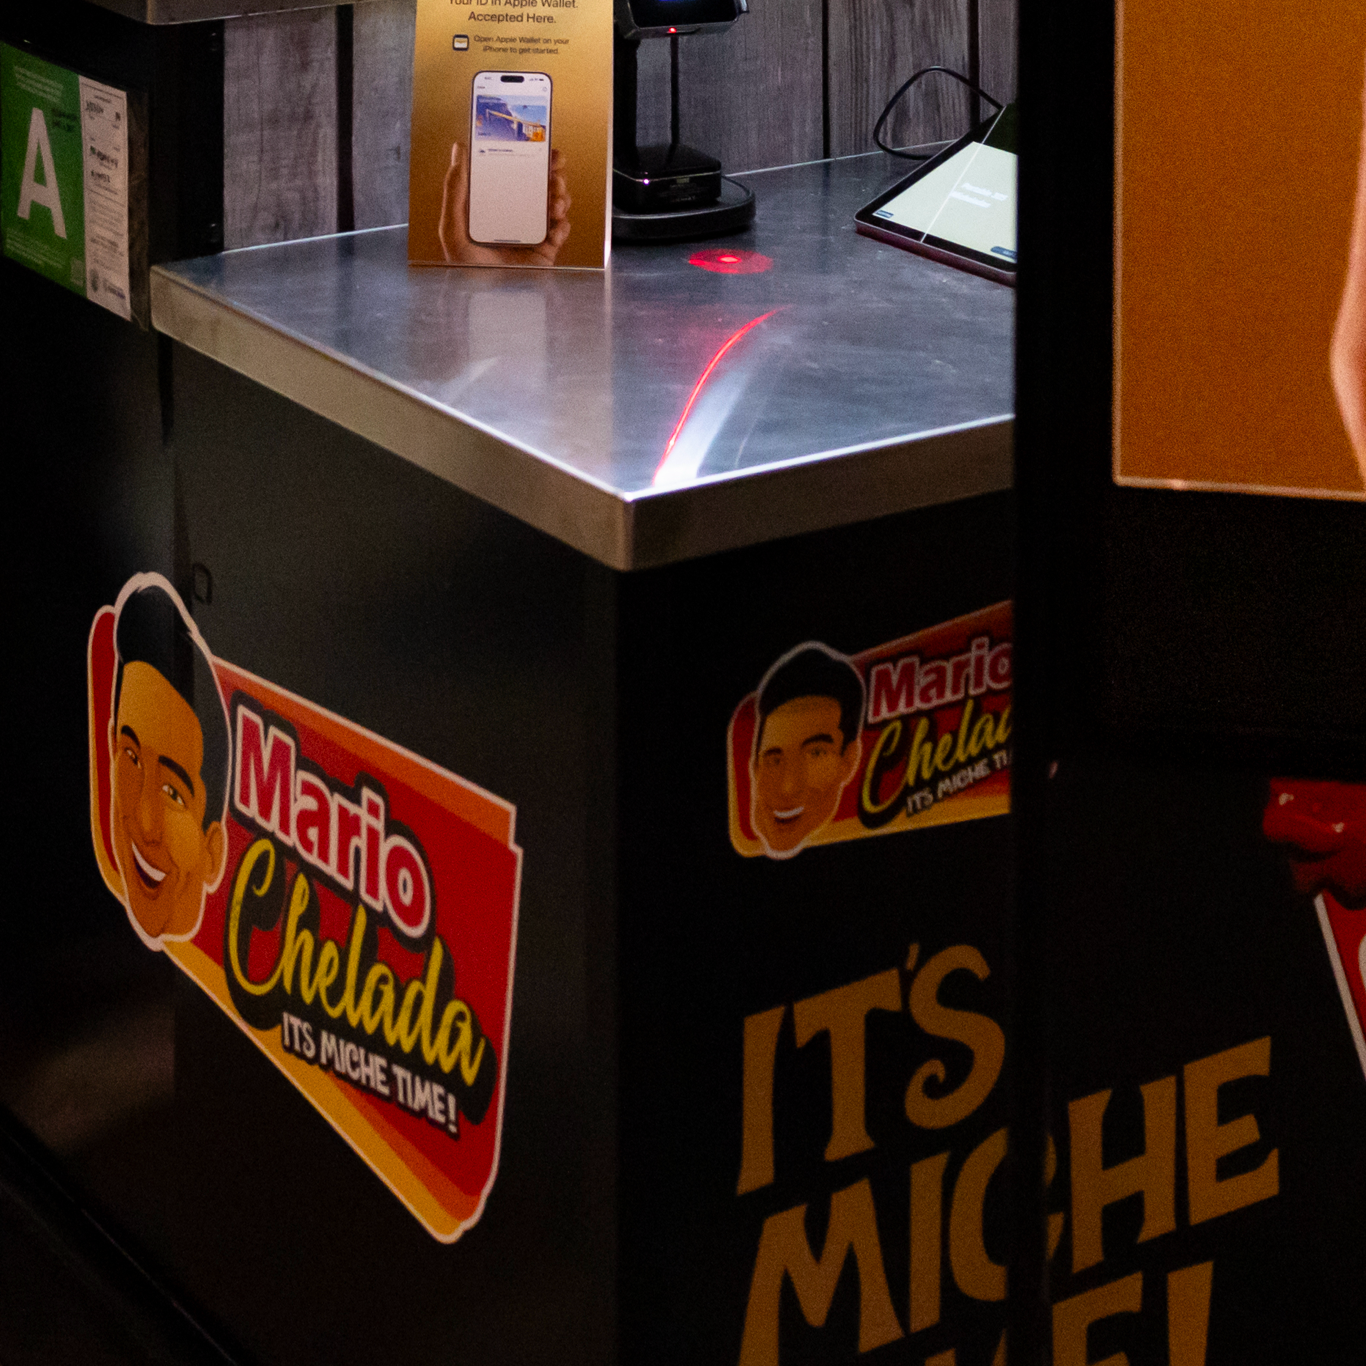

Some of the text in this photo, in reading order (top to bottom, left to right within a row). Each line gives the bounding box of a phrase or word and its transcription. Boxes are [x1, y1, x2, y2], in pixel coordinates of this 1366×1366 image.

[467, 11, 557, 24] Accepted Here.
[16, 105, 68, 240] A
[867, 635, 1012, 725] Mario
[233, 702, 432, 939] Mario
[229, 838, 487, 1088] Chelada
[319, 1029, 391, 1096] MICHE
[391, 1062, 458, 1134] TIME!
[736, 942, 1006, 1196] IT'S
